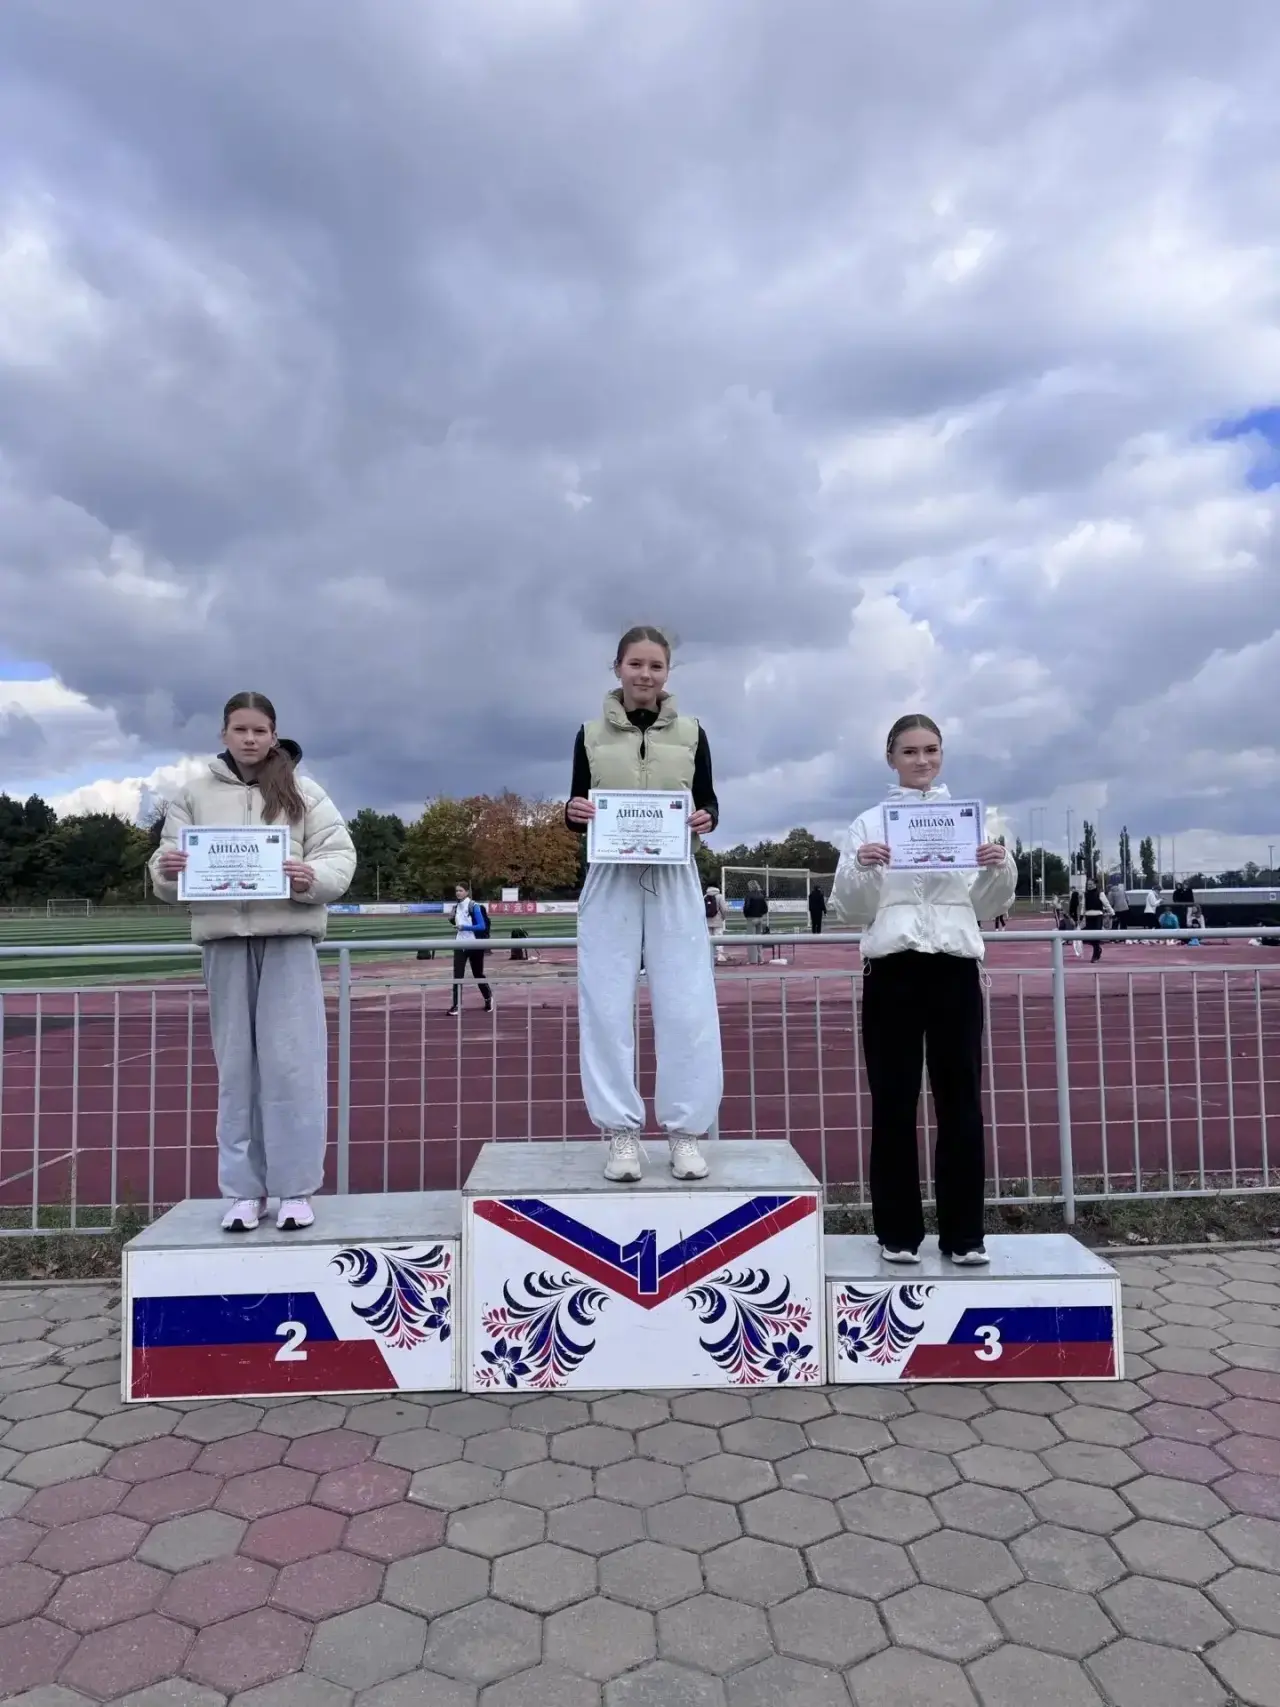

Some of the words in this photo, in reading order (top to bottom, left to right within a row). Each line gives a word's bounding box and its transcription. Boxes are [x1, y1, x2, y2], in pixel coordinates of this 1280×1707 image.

[616, 808, 664, 819] ДИПЛОМ
[908, 818, 955, 828] ДИПЛОМ
[208, 843, 260, 854] ДИПЛОМ
[620, 1229, 659, 1294] 1
[274, 1321, 308, 1362] 2
[974, 1325, 1003, 1362] 3
